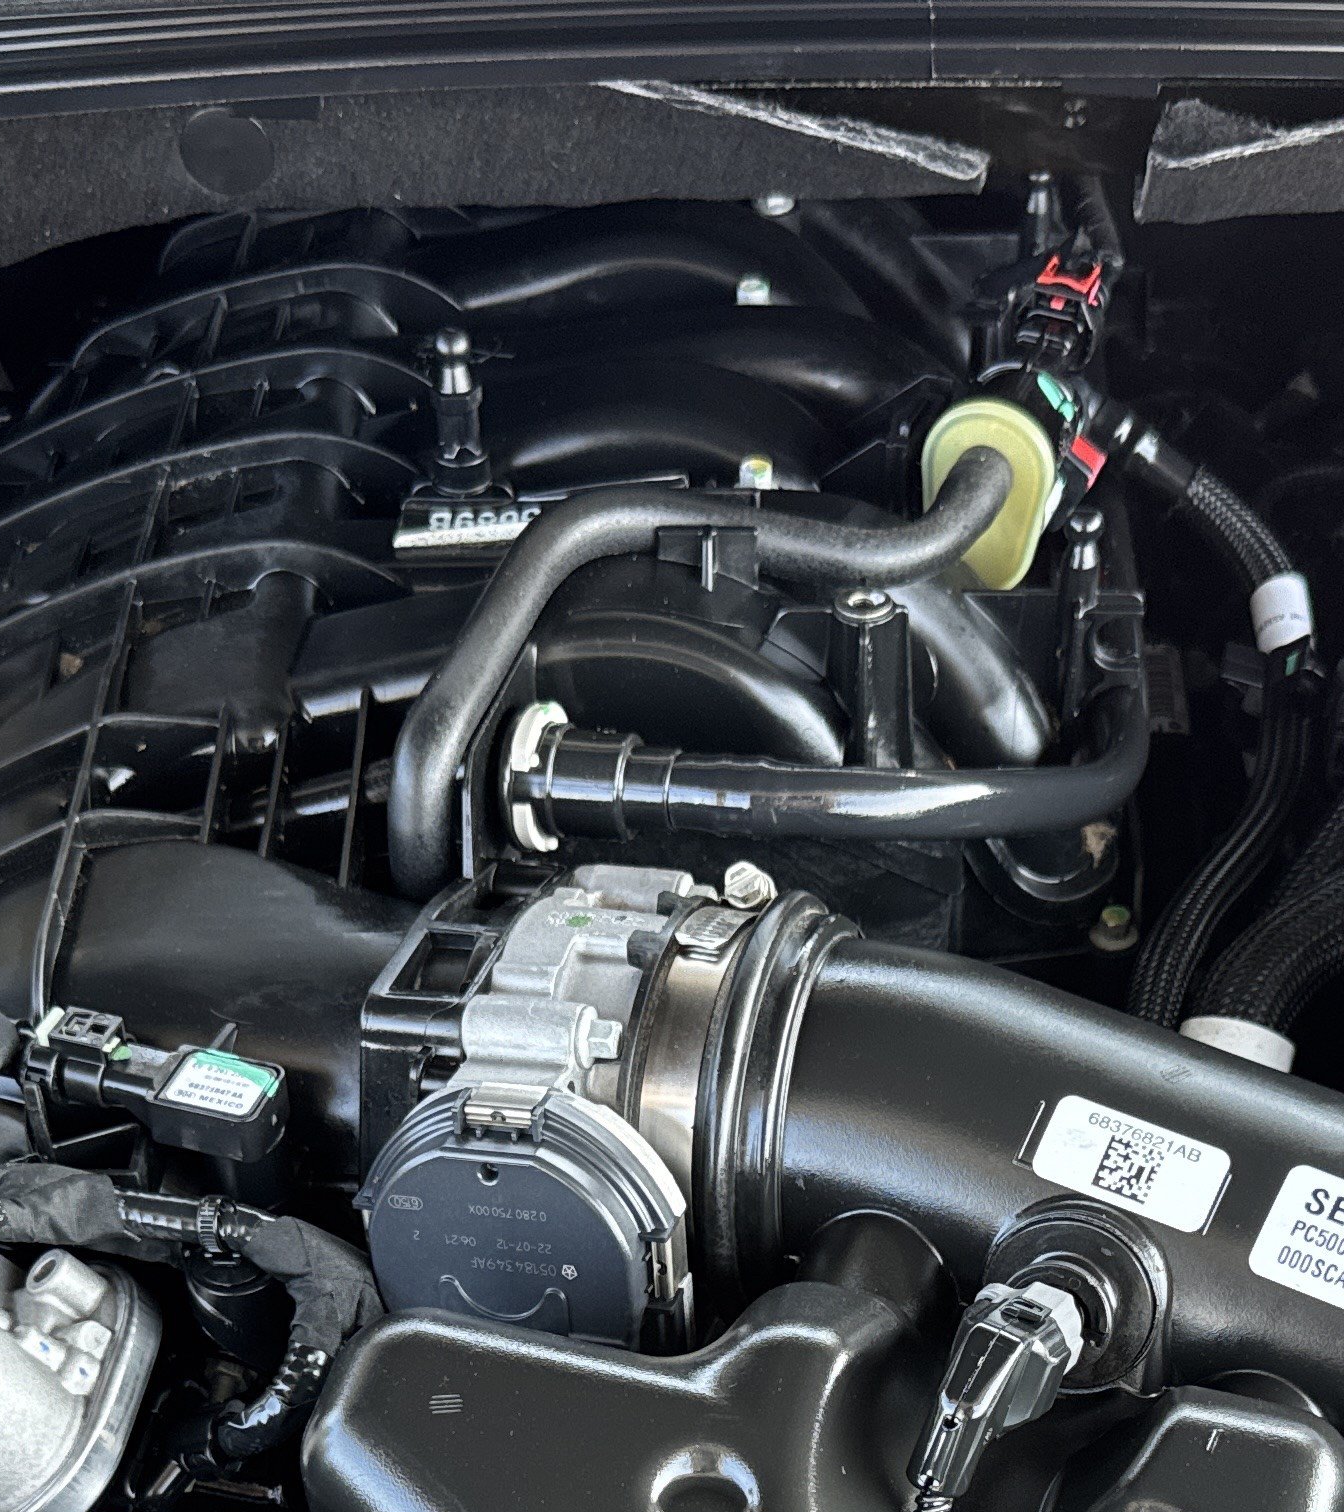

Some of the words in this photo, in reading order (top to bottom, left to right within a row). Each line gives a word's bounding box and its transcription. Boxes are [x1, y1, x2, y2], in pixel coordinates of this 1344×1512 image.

[198, 1095, 244, 1109] MEXICO
[1087, 1111, 1202, 1164] 68376821AB
[413, 1229, 421, 1241] 2
[496, 1238, 552, 1254] 22-07-12
